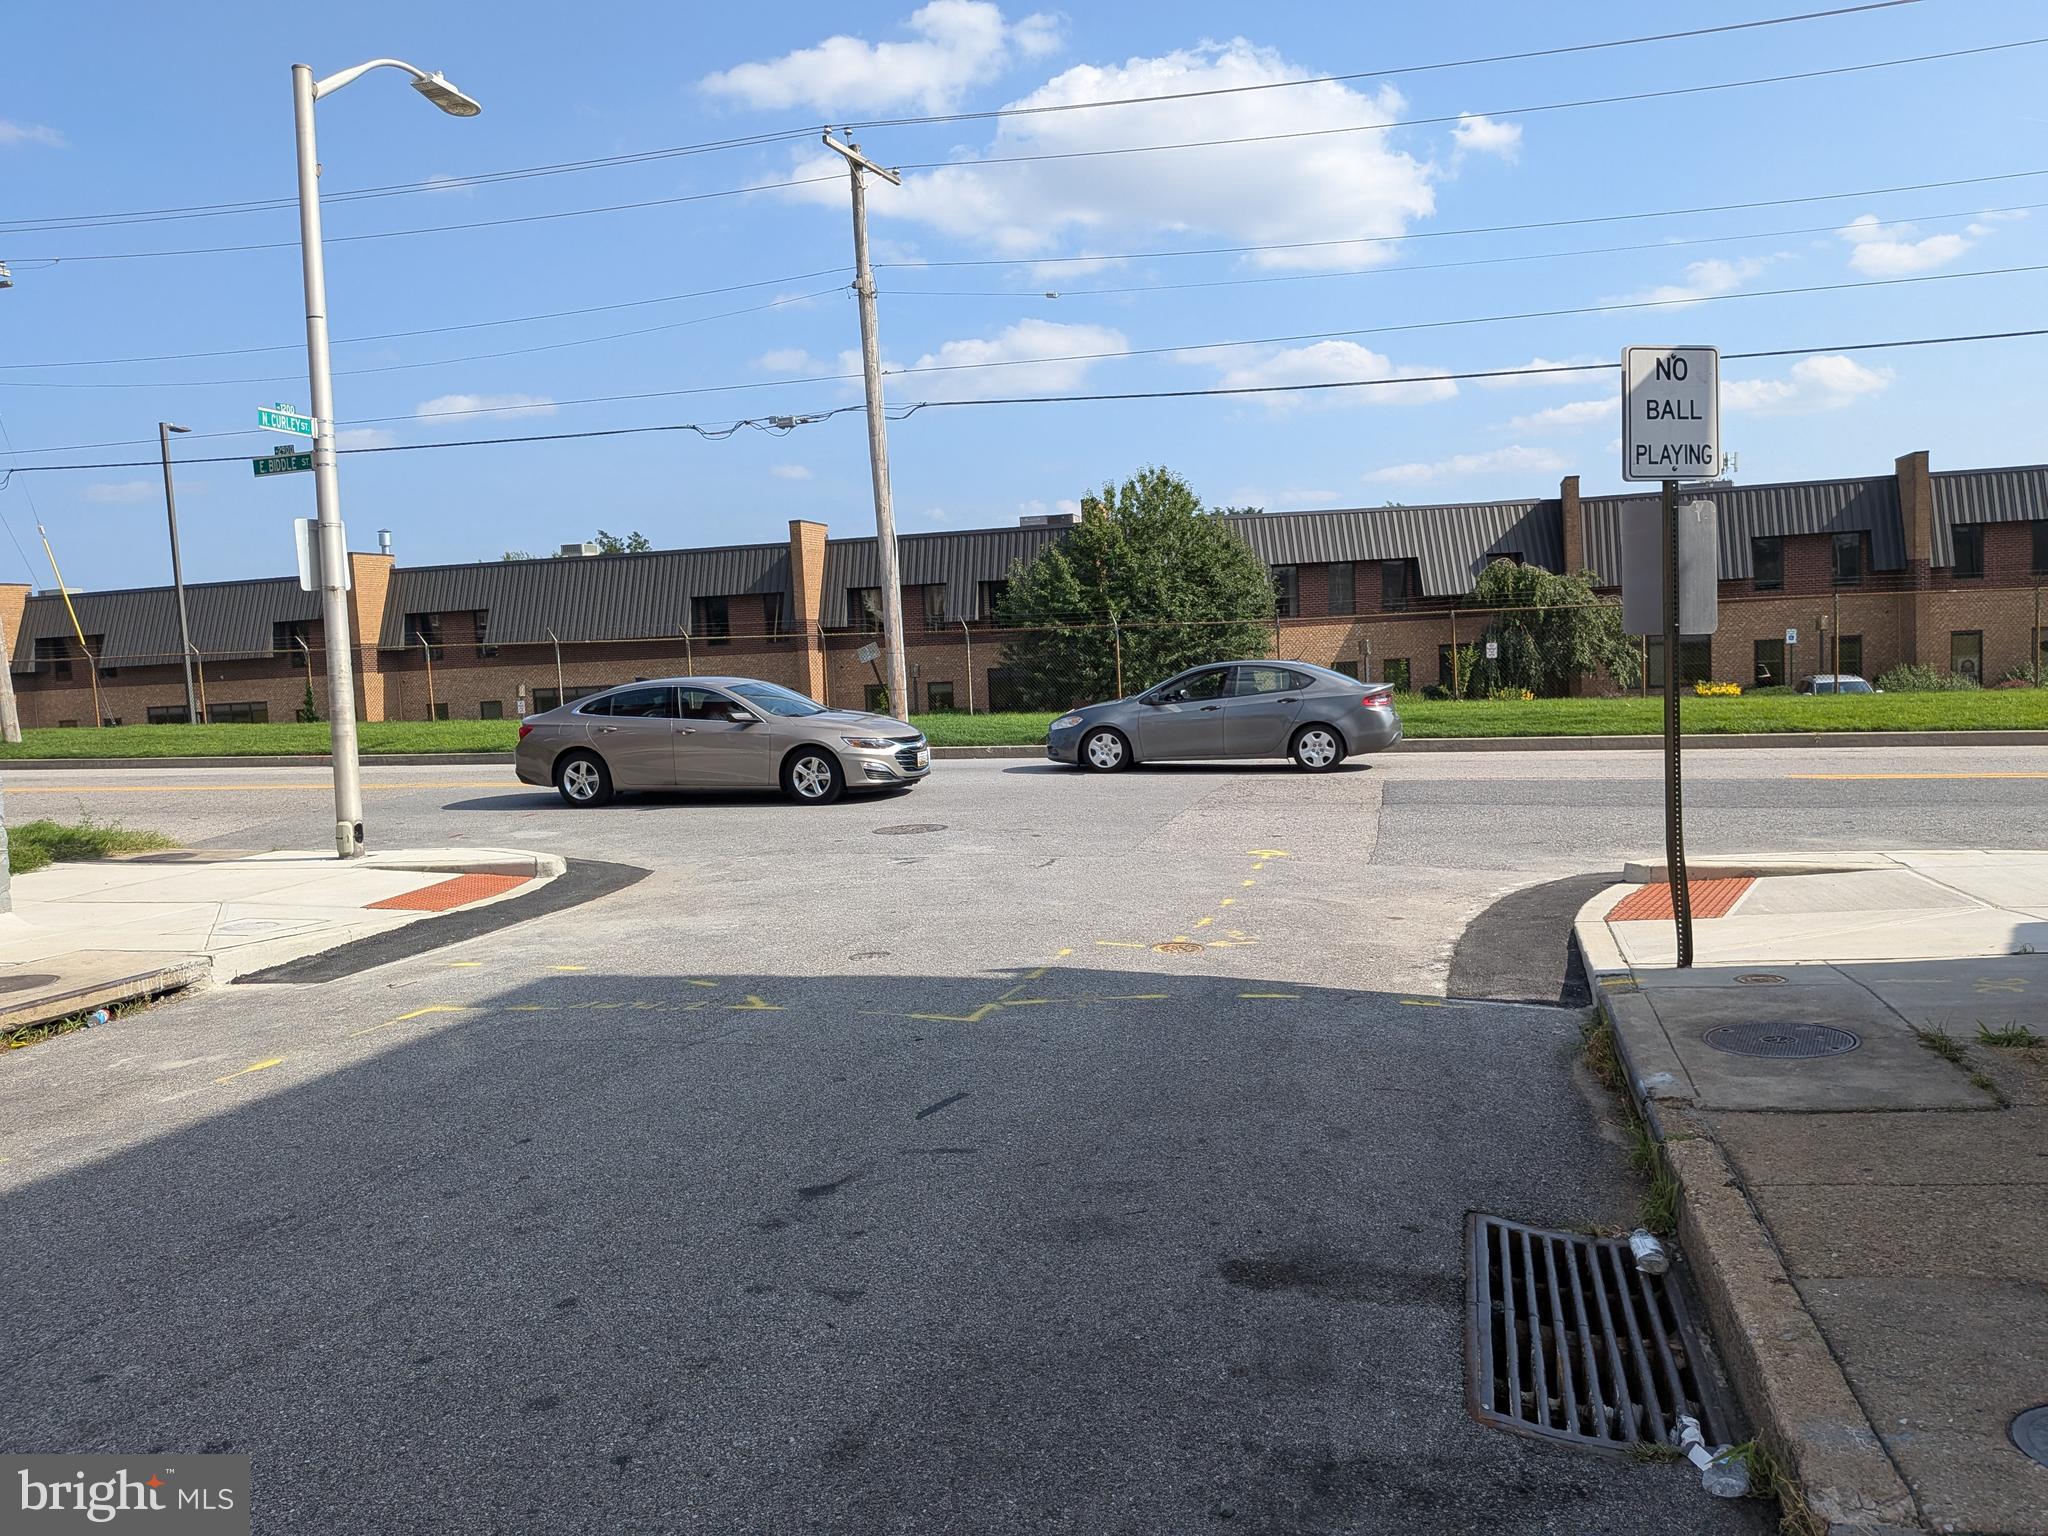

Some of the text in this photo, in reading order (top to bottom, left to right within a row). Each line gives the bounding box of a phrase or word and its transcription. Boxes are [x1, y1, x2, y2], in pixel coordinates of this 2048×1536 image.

[1655, 356, 1688, 381] NO
[1646, 399, 1702, 420] BALL
[271, 413, 301, 431] CURLEY
[268, 457, 297, 472] BIDDLE
[1635, 443, 1713, 465] PLAYING
